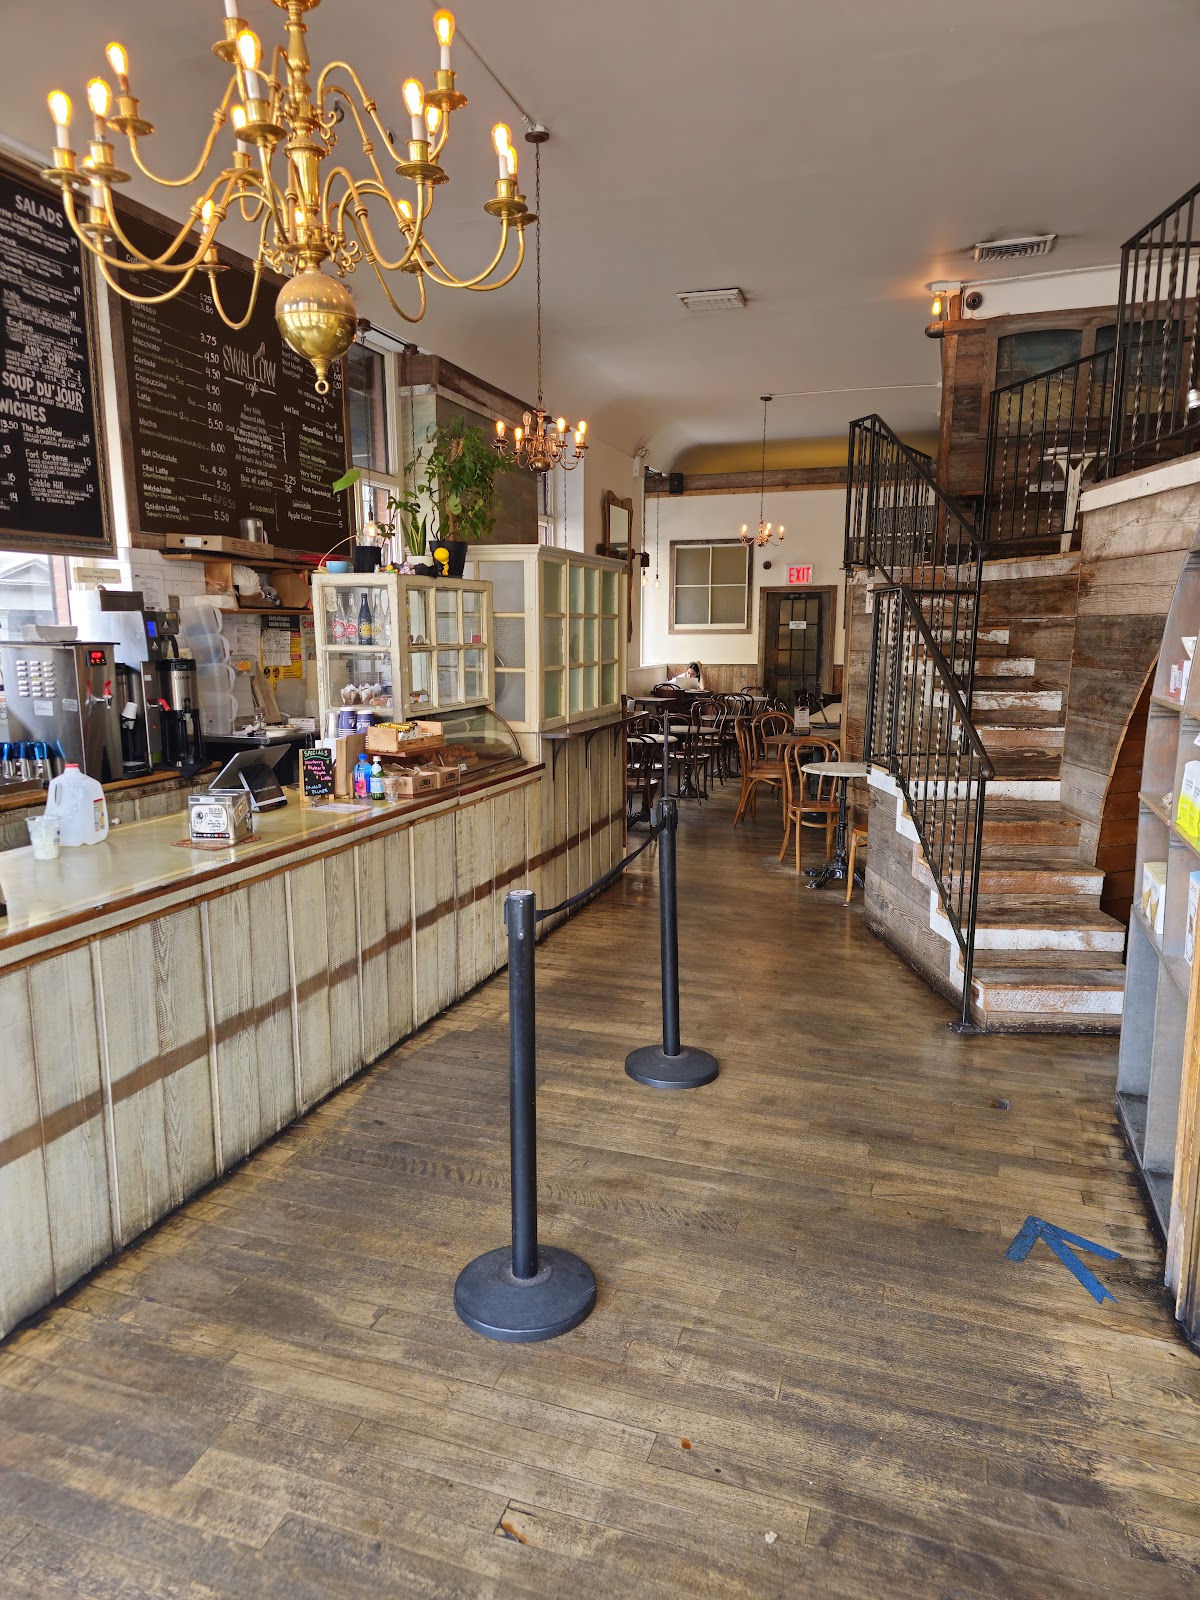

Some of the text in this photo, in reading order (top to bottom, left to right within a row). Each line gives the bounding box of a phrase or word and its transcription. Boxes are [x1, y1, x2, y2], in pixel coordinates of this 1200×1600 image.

[15, 194, 64, 229] SALADS
[73, 285, 81, 296] 14
[70, 311, 77, 320] 14
[6, 316, 34, 333] Endive
[131, 318, 161, 335] Americano
[70, 338, 79, 347] 14
[132, 336, 161, 352] Macchiato
[200, 332, 217, 346] 3.75
[24, 346, 67, 367] ADD-ONS
[203, 352, 220, 364] 4.50
[222, 342, 277, 388] SWALLOW
[205, 366, 221, 380] 4.50
[135, 373, 168, 389] Cappuccino
[2, 371, 35, 394] SOUP
[54, 387, 85, 408] JOUR
[205, 383, 221, 396] 4.50
[207, 401, 222, 413] 5.00
[21, 422, 34, 433] The
[36, 425, 63, 438] Swallow
[208, 417, 223, 431] 5.50
[82, 433, 90, 444] 15
[3, 444, 11, 454] 13
[141, 447, 151, 457] Hot
[210, 442, 226, 453] 6.00
[25, 448, 92, 466] Fort Greene 15
[141, 463, 155, 471] Chai
[211, 465, 228, 477] 4.50
[7, 472, 16, 482] 16
[284, 473, 297, 486] 2.25
[28, 478, 51, 488] Cobble
[52, 481, 64, 490] Hill
[86, 484, 94, 493] 15
[216, 480, 232, 492] 5.50
[284, 484, 293, 494] 36
[9, 492, 19, 502] 14
[165, 504, 180, 514] Latte
[213, 510, 230, 522] 5.50
[287, 510, 343, 529] Apple Cider 5
[788, 566, 812, 584] EXIT
